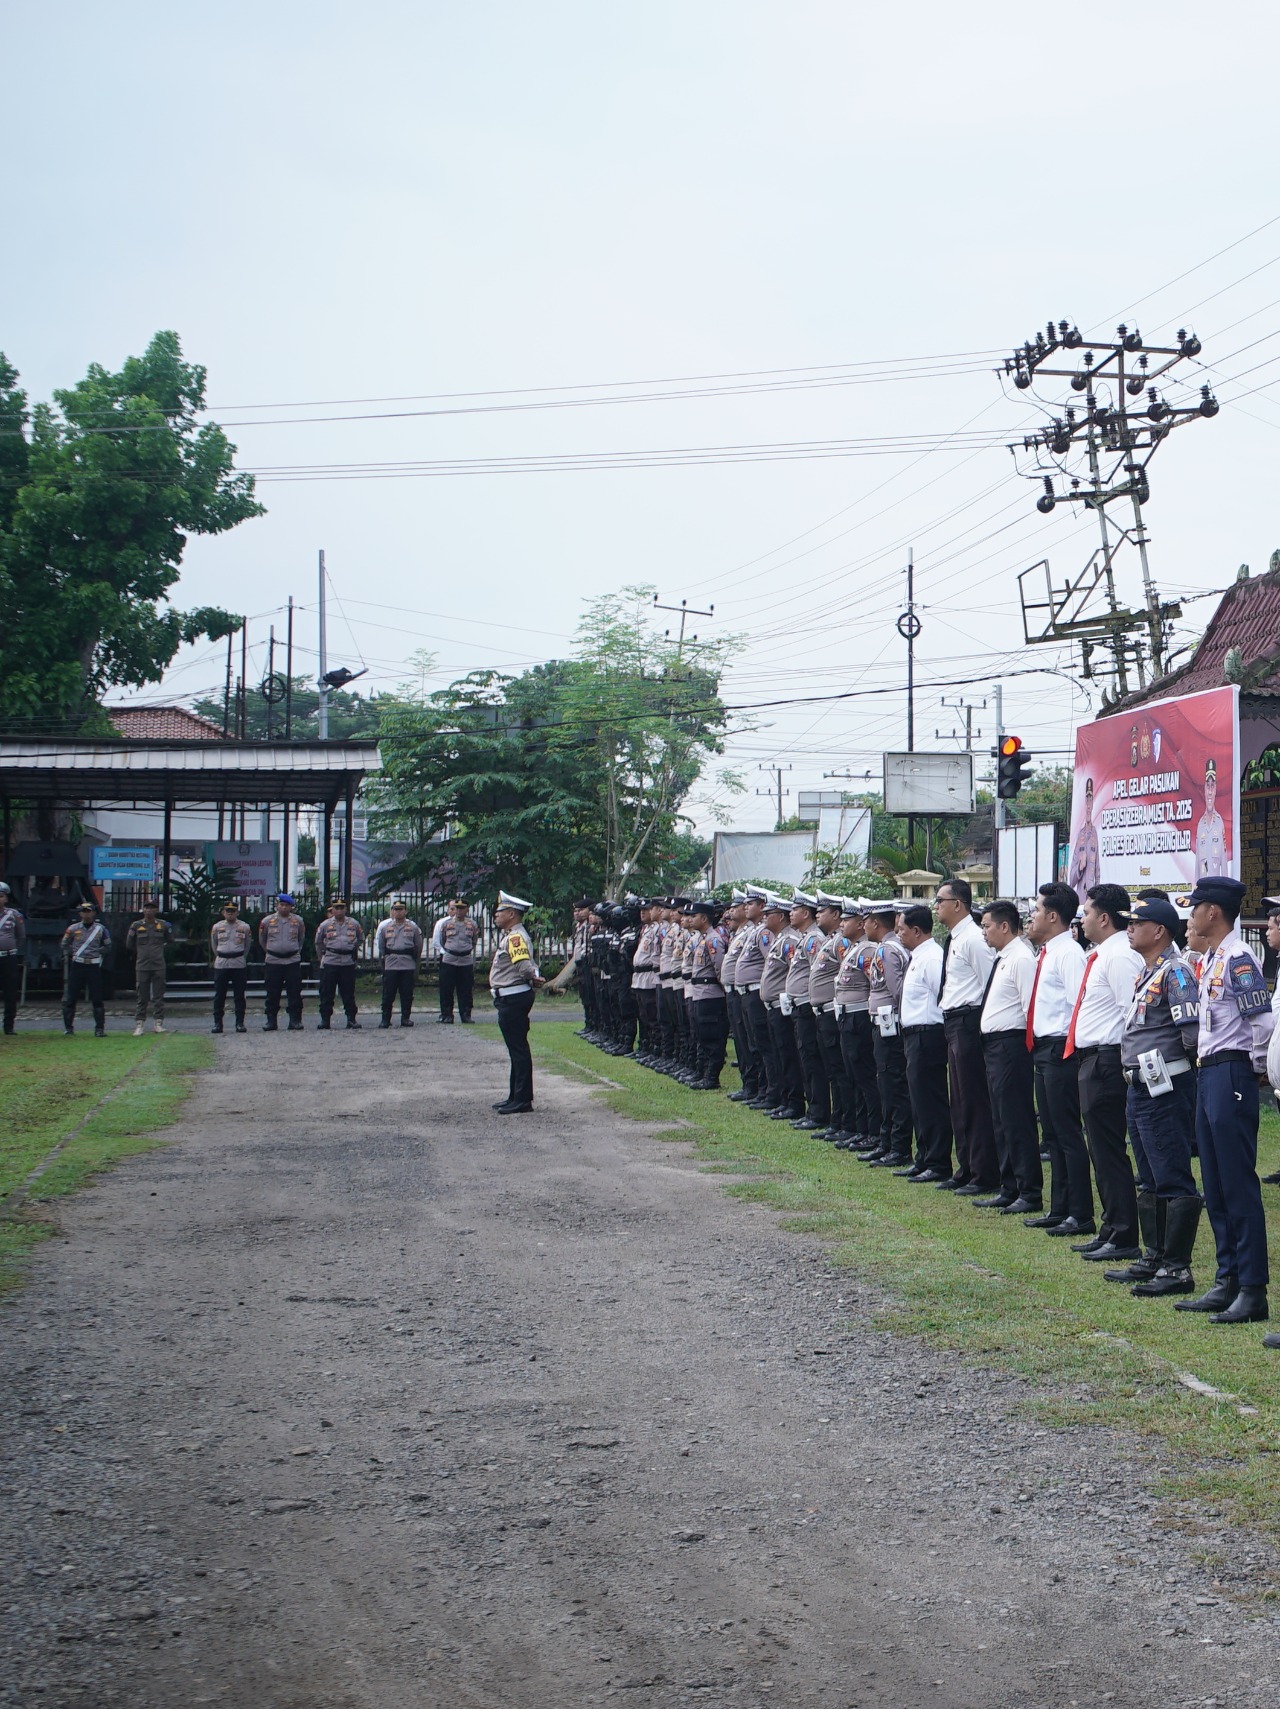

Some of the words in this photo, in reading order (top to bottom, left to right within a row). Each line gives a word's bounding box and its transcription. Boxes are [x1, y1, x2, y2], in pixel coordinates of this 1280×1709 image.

[1112, 779, 1129, 800] APEL
[1128, 775, 1149, 798] GELAR
[1149, 770, 1180, 795] PASUKAN
[1101, 807, 1127, 830] OPERASI
[1127, 804, 1148, 827] ZEBRA
[1176, 799, 1193, 821] 2025
[1101, 836, 1125, 857] POLRES
[1125, 833, 1143, 855] OGAN
[1143, 829, 1177, 854] KOMERING
